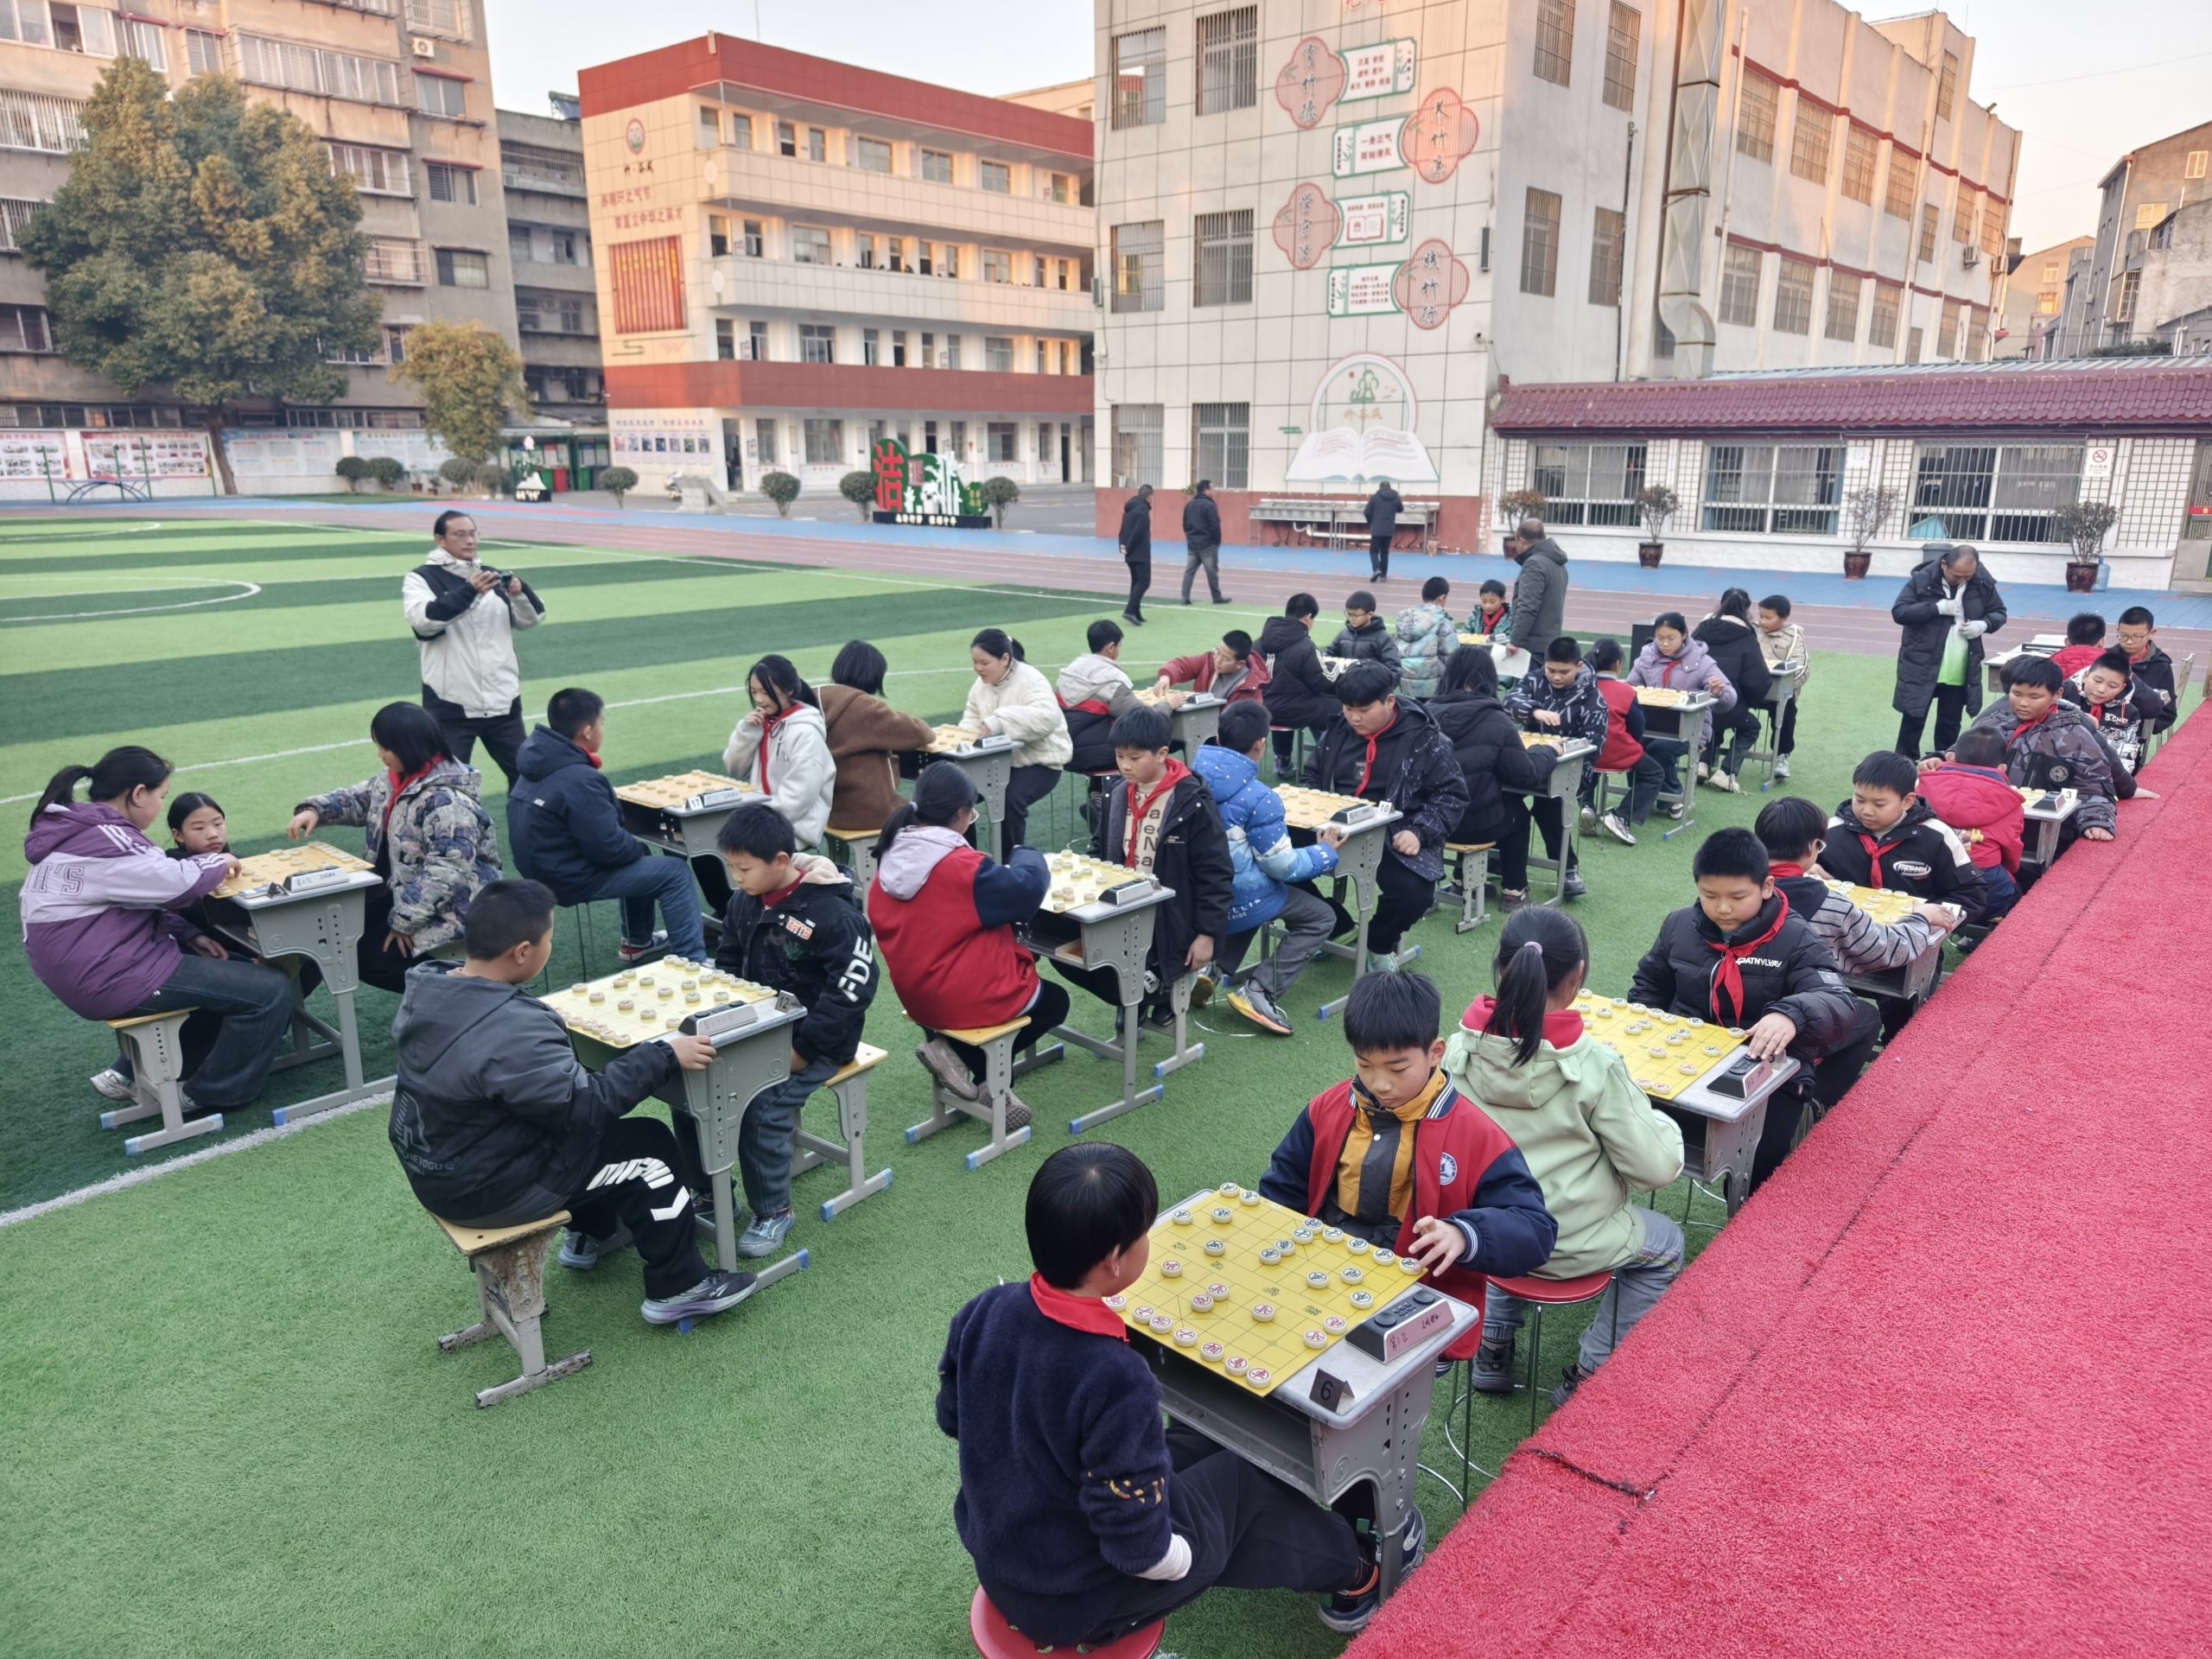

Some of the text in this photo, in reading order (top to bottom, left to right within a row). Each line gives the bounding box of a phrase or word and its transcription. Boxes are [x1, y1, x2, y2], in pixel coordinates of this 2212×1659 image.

[1361, 133, 1393, 145] 一身正气
[1360, 148, 1392, 161] 两袖清风
[873, 442, 905, 512] 洁
[2065, 791, 2072, 799] 3
[1380, 804, 1389, 813] 10
[778, 995, 790, 1010] 12
[1319, 1380, 1334, 1402] 6
